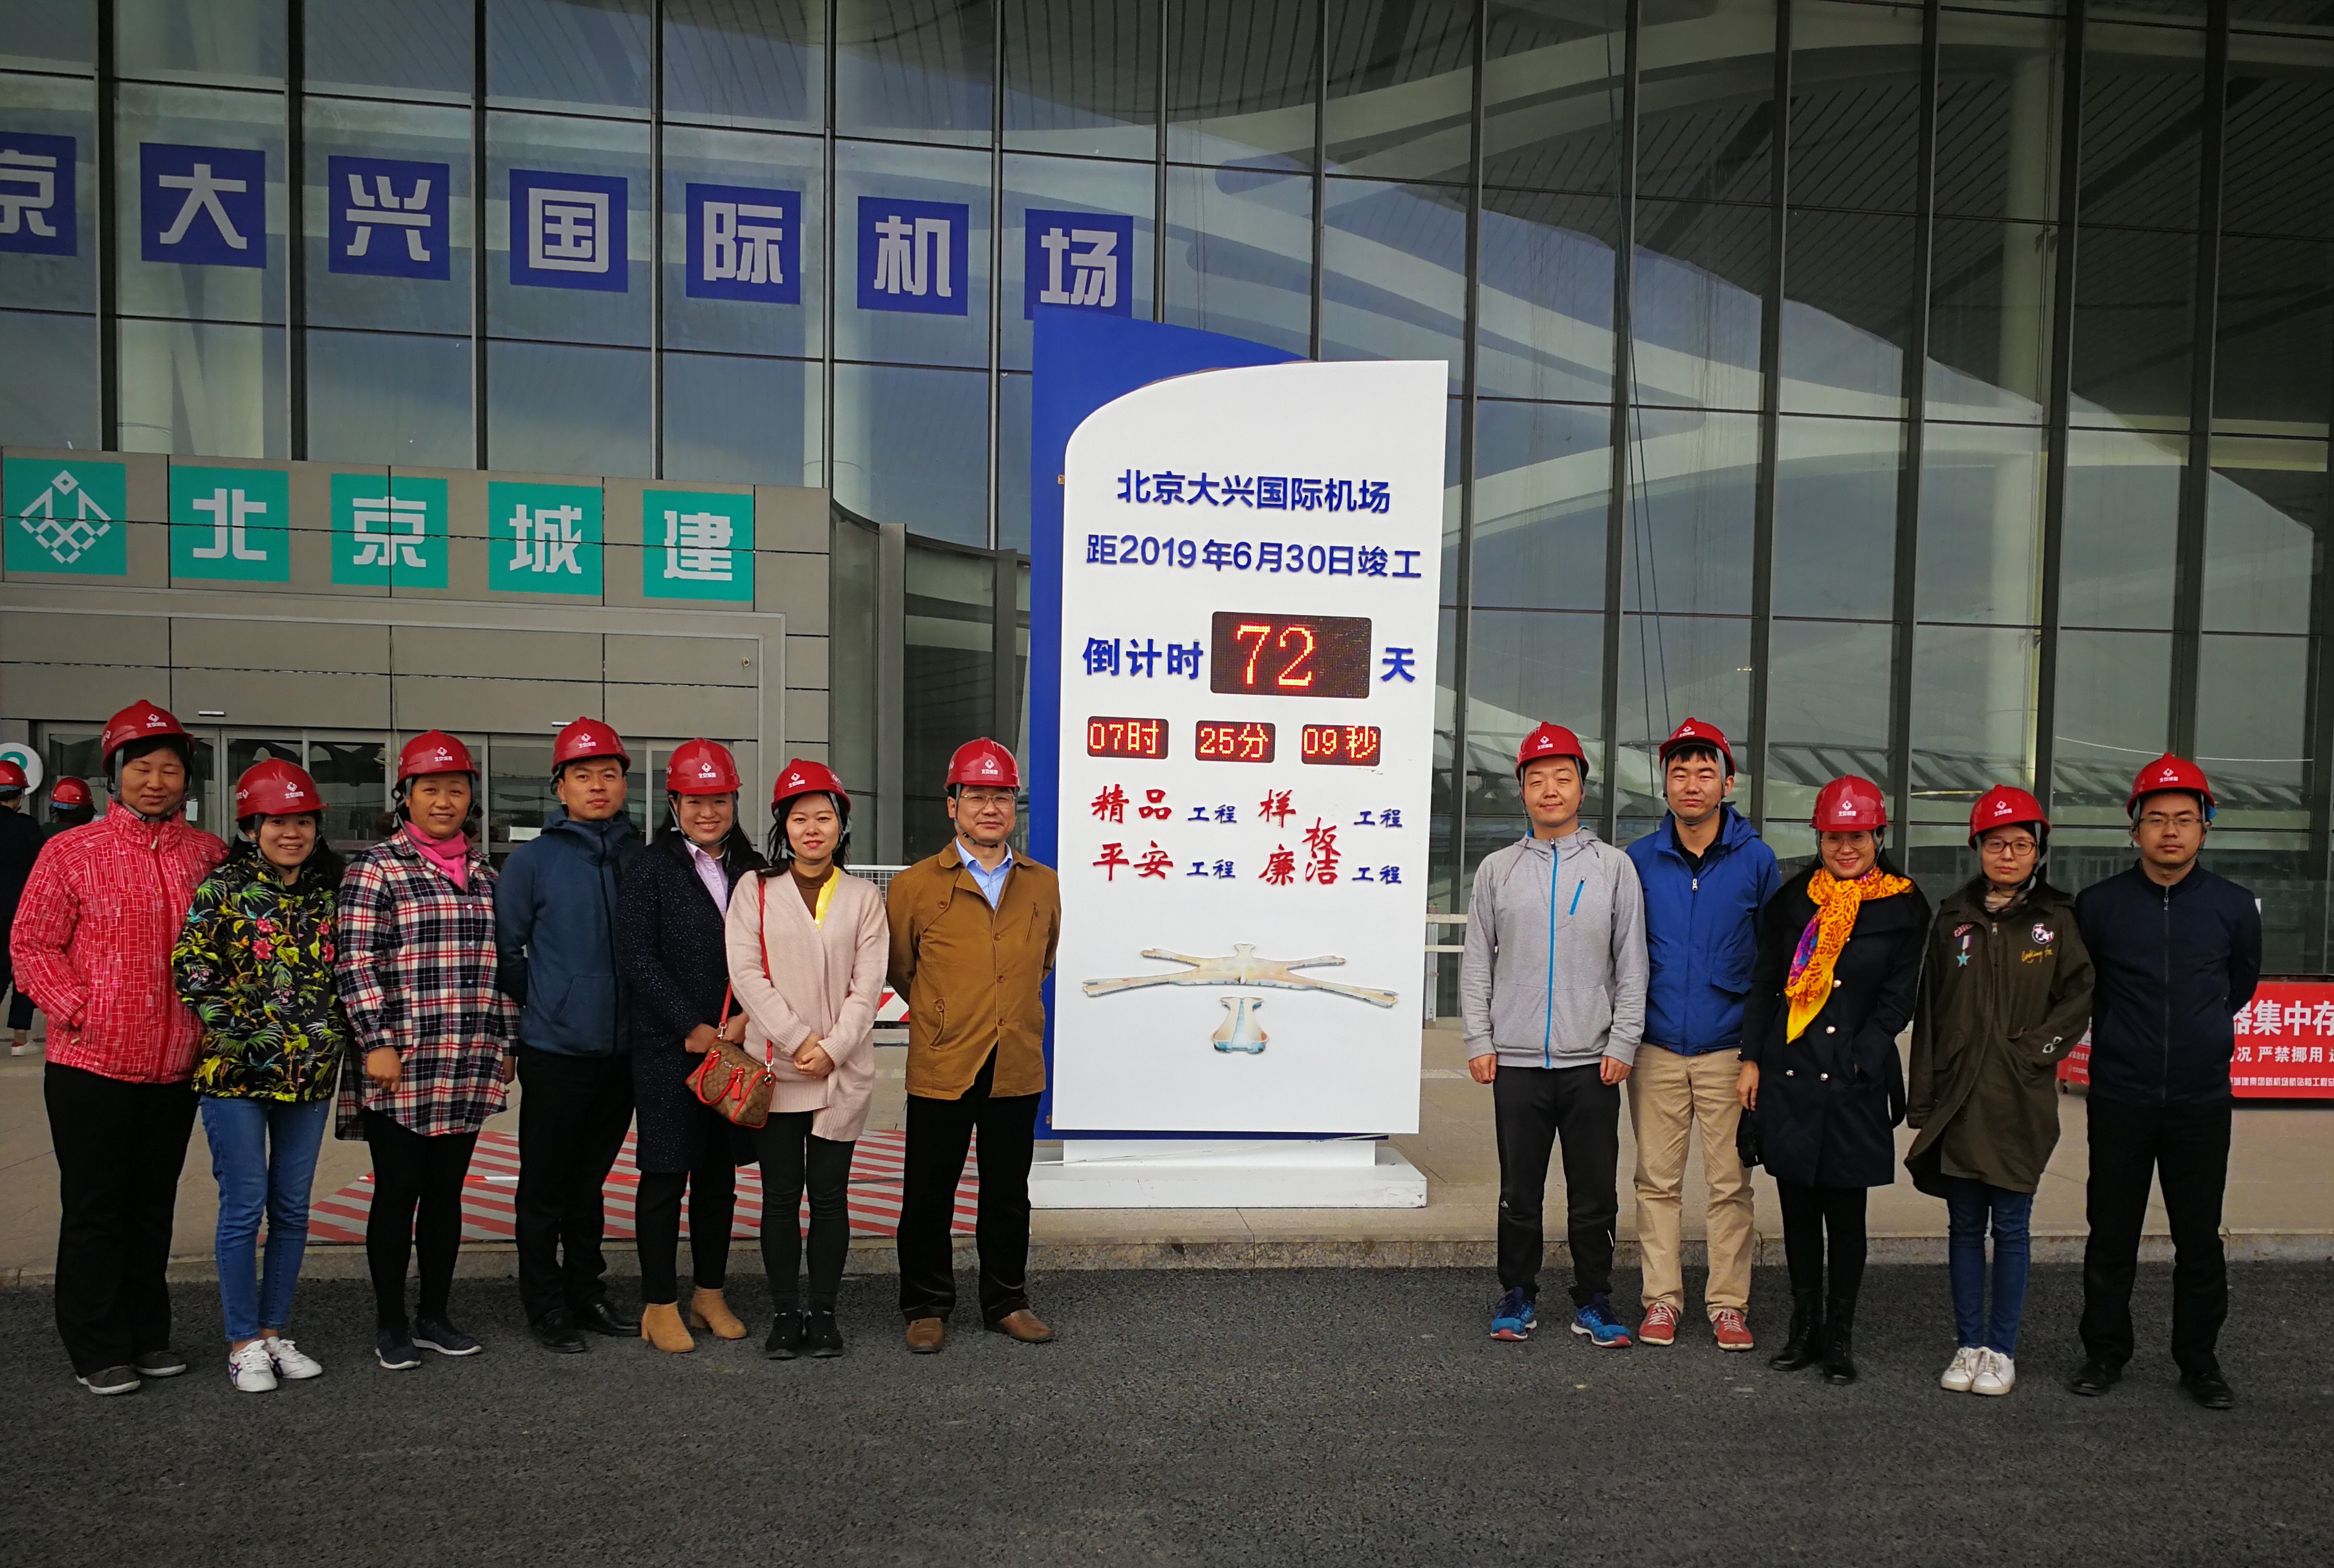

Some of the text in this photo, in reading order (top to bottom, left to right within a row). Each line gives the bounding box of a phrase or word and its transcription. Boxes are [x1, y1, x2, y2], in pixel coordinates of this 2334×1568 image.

[1117, 468, 1390, 514] 北京大兴国际机场
[193, 488, 733, 581] 北京城建
[1086, 533, 1422, 579] 距2019年6月30日竣工
[1082, 624, 1416, 688] 倒计时 72 天
[1089, 720, 1377, 759] 07时 25分 09秒
[1091, 783, 1172, 825] 精品
[1187, 804, 1238, 825] 工程
[1353, 808, 1403, 829] 工程
[1092, 840, 1402, 886] 平安 工程 廉洁 工程
[2257, 1046, 2323, 1063] 严禁挪用
